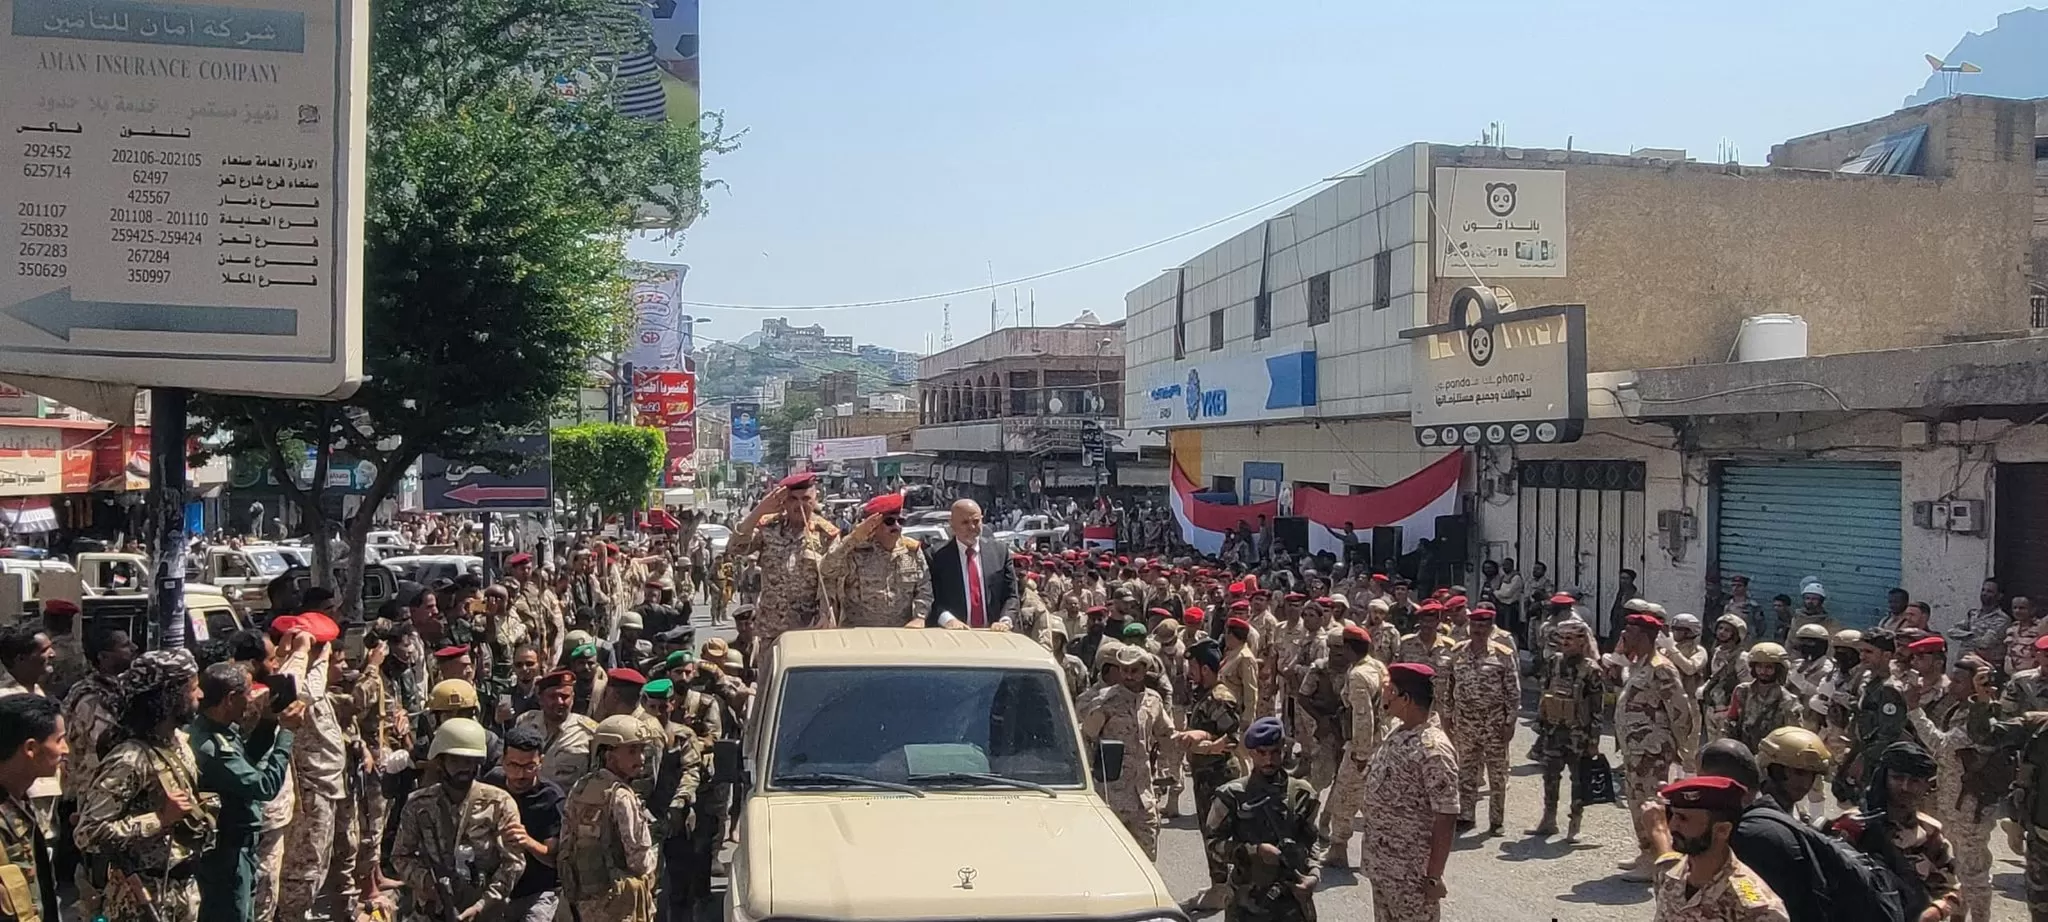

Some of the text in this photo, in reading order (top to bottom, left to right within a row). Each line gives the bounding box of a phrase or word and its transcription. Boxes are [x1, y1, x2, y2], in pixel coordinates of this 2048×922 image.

[203, 18, 277, 45] شركة
[37, 51, 281, 84] AMAN INSURANCE COMPANY
[16, 121, 83, 134] فاكس
[119, 125, 191, 138] تلفون
[24, 143, 72, 159] 292452
[111, 149, 202, 167] 202106-202105
[221, 156, 252, 166] صنعاء
[255, 156, 285, 169] العامة
[23, 163, 72, 179] 625714
[133, 169, 169, 185] 62497
[240, 174, 264, 189] شارع
[266, 175, 285, 190] فرع
[288, 177, 319, 189] صنعاء
[128, 190, 171, 205] 425567
[18, 202, 67, 218] 201107
[110, 208, 153, 224] 201108
[167, 210, 209, 226] 201110
[20, 222, 69, 238] 250832
[1462, 219, 1541, 234] باندا فون
[111, 228, 202, 245] 259425-259424
[19, 242, 68, 259] 267283
[127, 249, 170, 264] 267284
[217, 253, 251, 266] عدن
[18, 262, 67, 278] 350629
[128, 269, 171, 284] 350997
[1435, 394, 1474, 408] مستلزماتها
[1475, 392, 1500, 405] وجميع
